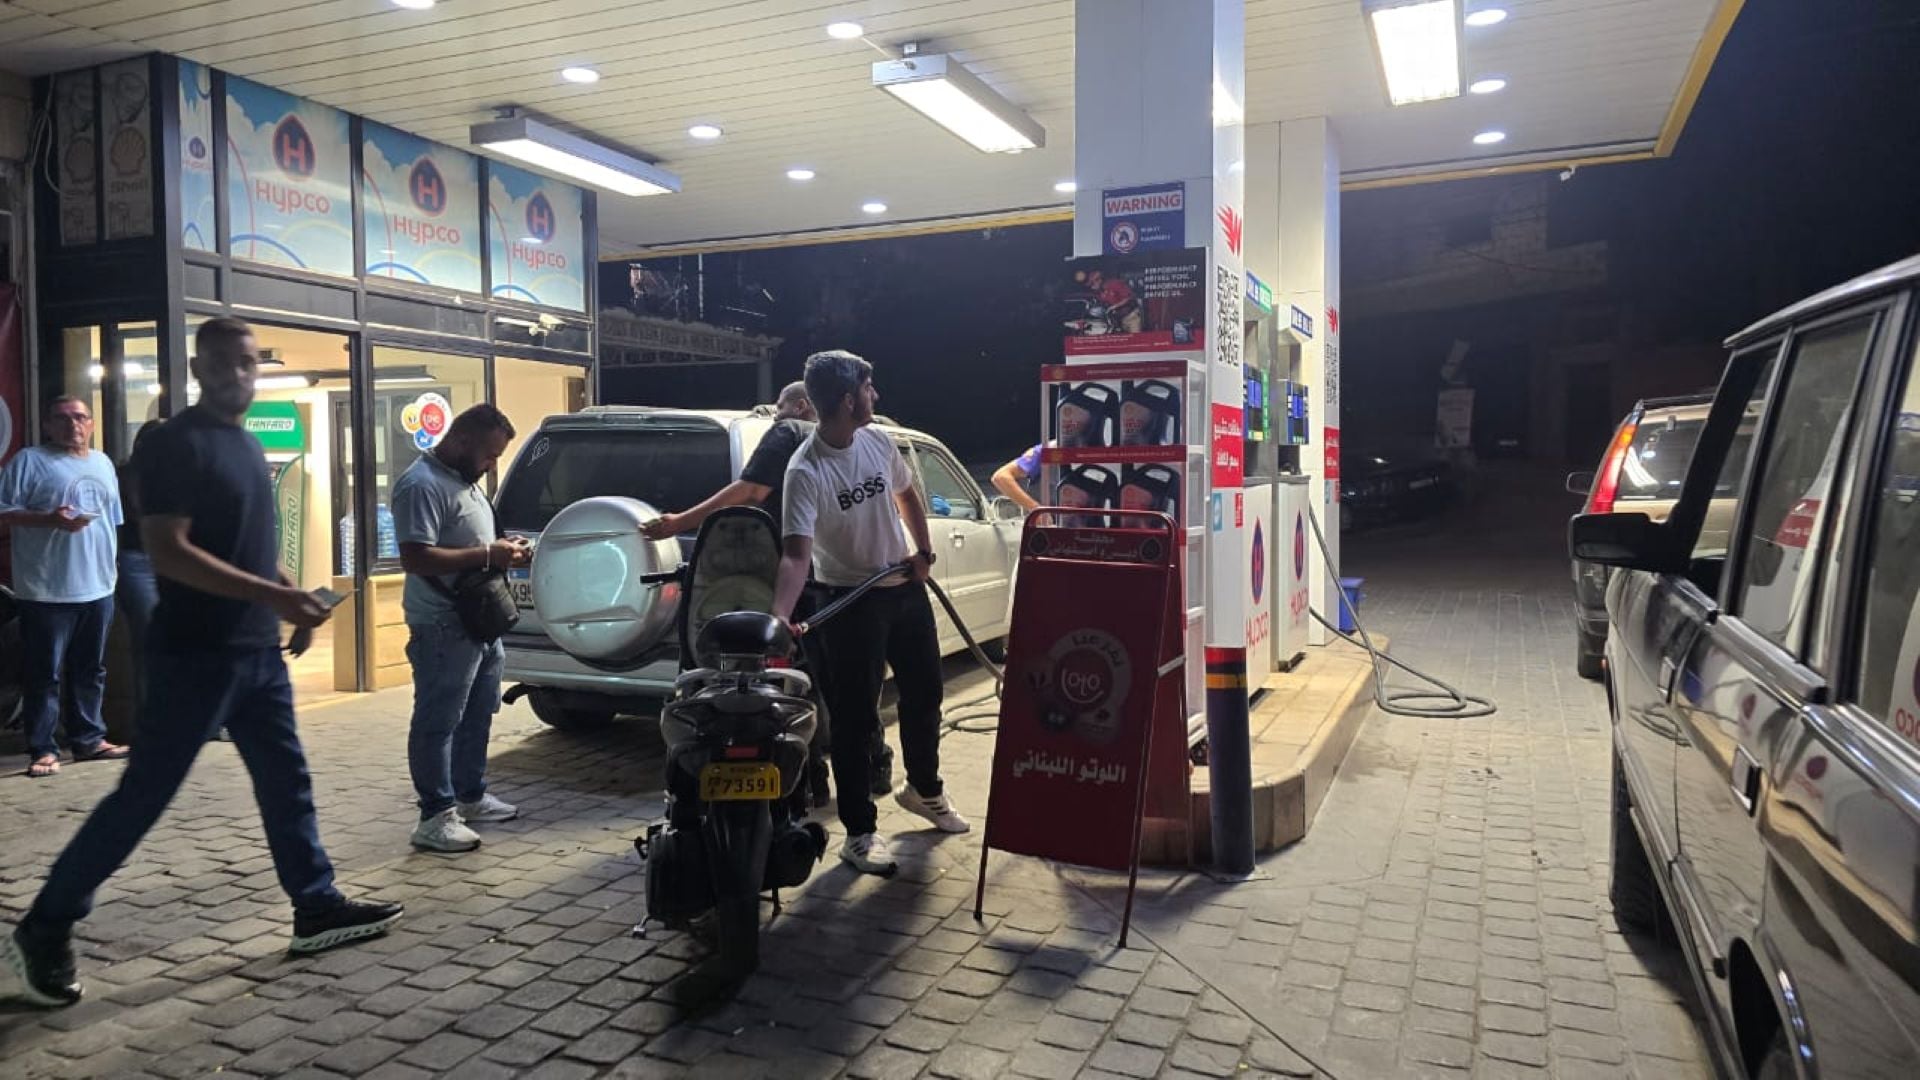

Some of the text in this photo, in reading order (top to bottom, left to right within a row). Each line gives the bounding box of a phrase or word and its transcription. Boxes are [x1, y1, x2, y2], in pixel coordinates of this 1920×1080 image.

[256, 179, 331, 214] Hypco
[1106, 194, 1181, 214] WARNING
[393, 215, 461, 246] Hypco
[512, 243, 566, 270] Hypco
[837, 472, 886, 511] BOSS
